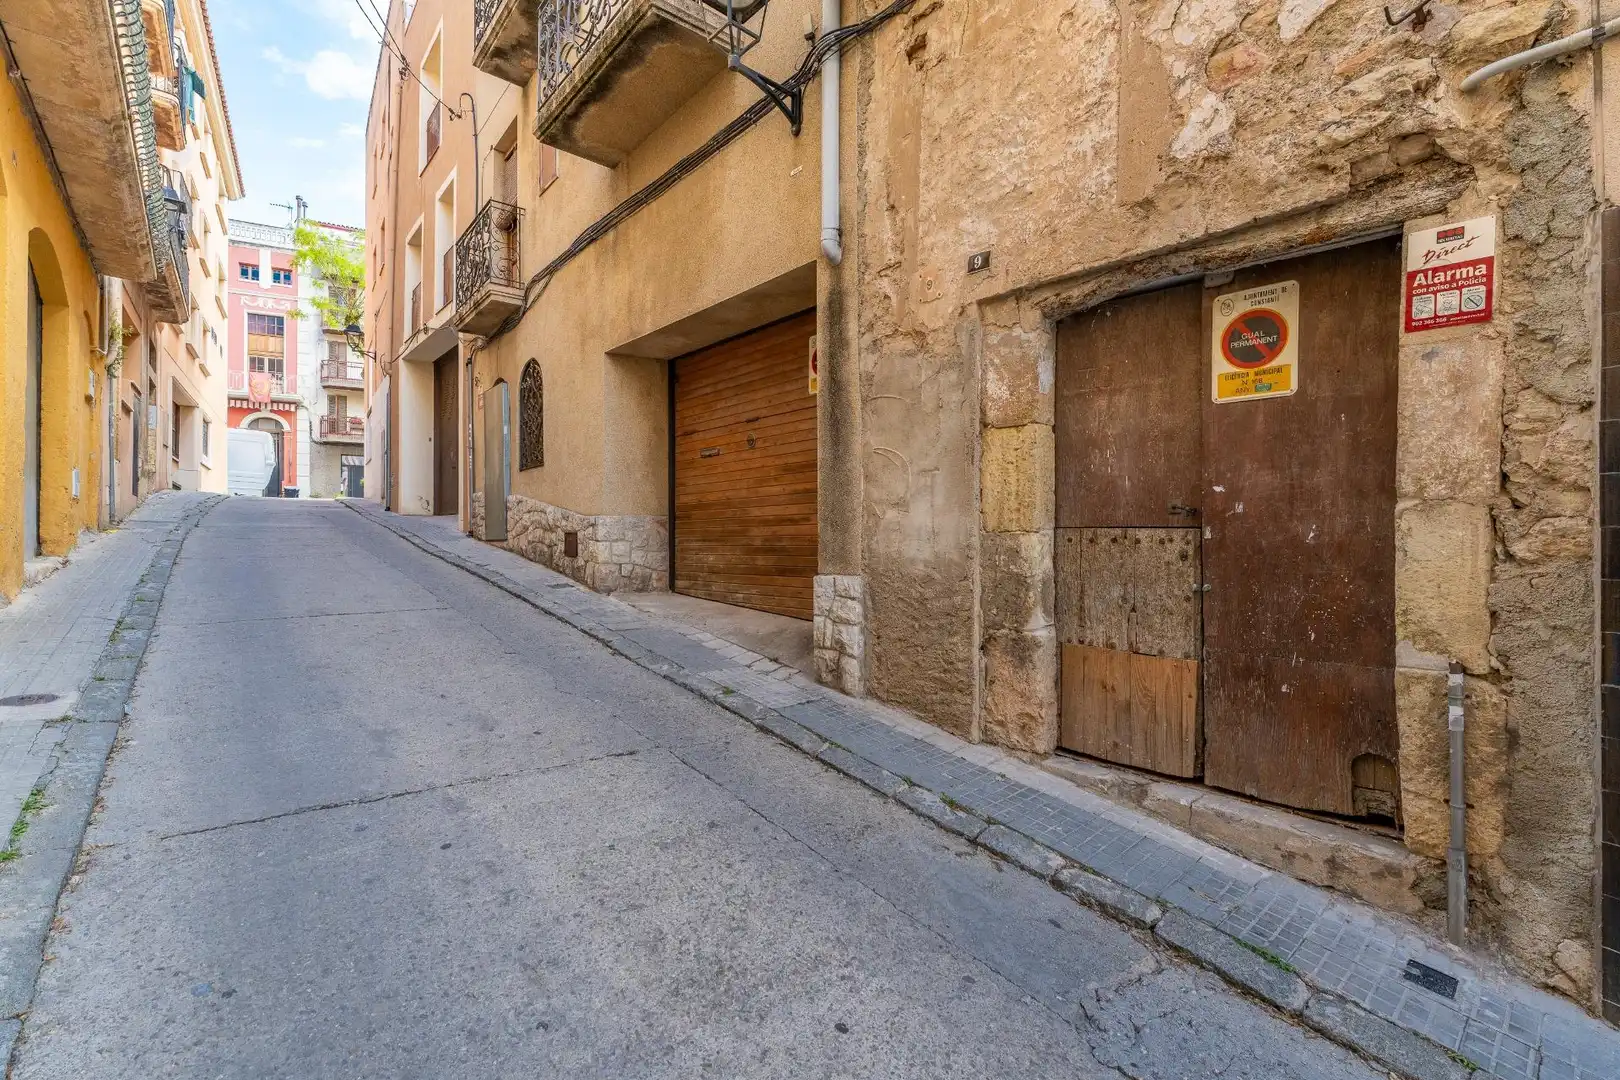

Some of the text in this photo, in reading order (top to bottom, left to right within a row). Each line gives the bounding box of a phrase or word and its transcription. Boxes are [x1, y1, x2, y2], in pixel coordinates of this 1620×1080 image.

[1421, 235, 1481, 265] Direct
[974, 255, 982, 269] 9
[1412, 264, 1487, 287] Alarma
[1412, 286, 1427, 295] con
[1428, 282, 1450, 292] aviso
[1230, 335, 1278, 349] PERMANENT
[1241, 330, 1266, 340] GUAL
